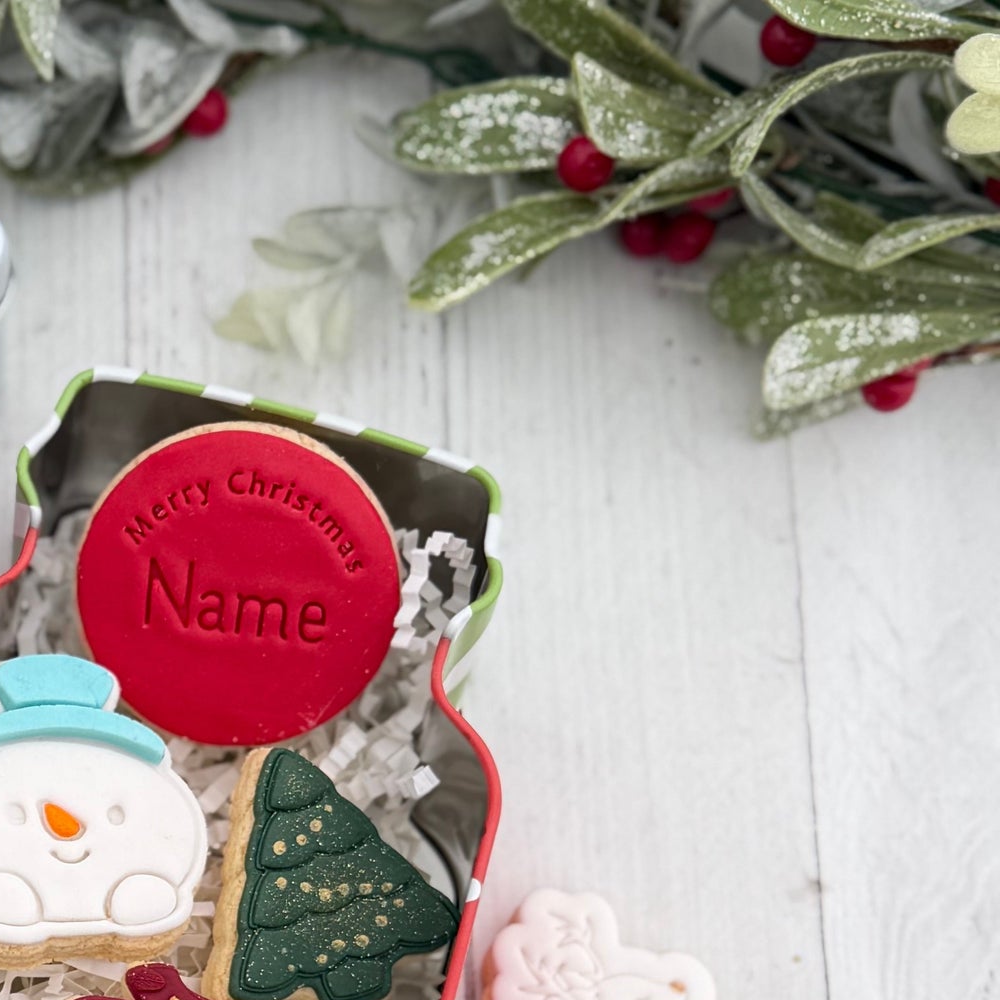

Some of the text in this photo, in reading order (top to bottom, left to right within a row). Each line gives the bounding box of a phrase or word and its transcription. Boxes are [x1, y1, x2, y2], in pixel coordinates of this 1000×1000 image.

[123, 470, 364, 574] Merry Christmas
[144, 556, 328, 644] Name
